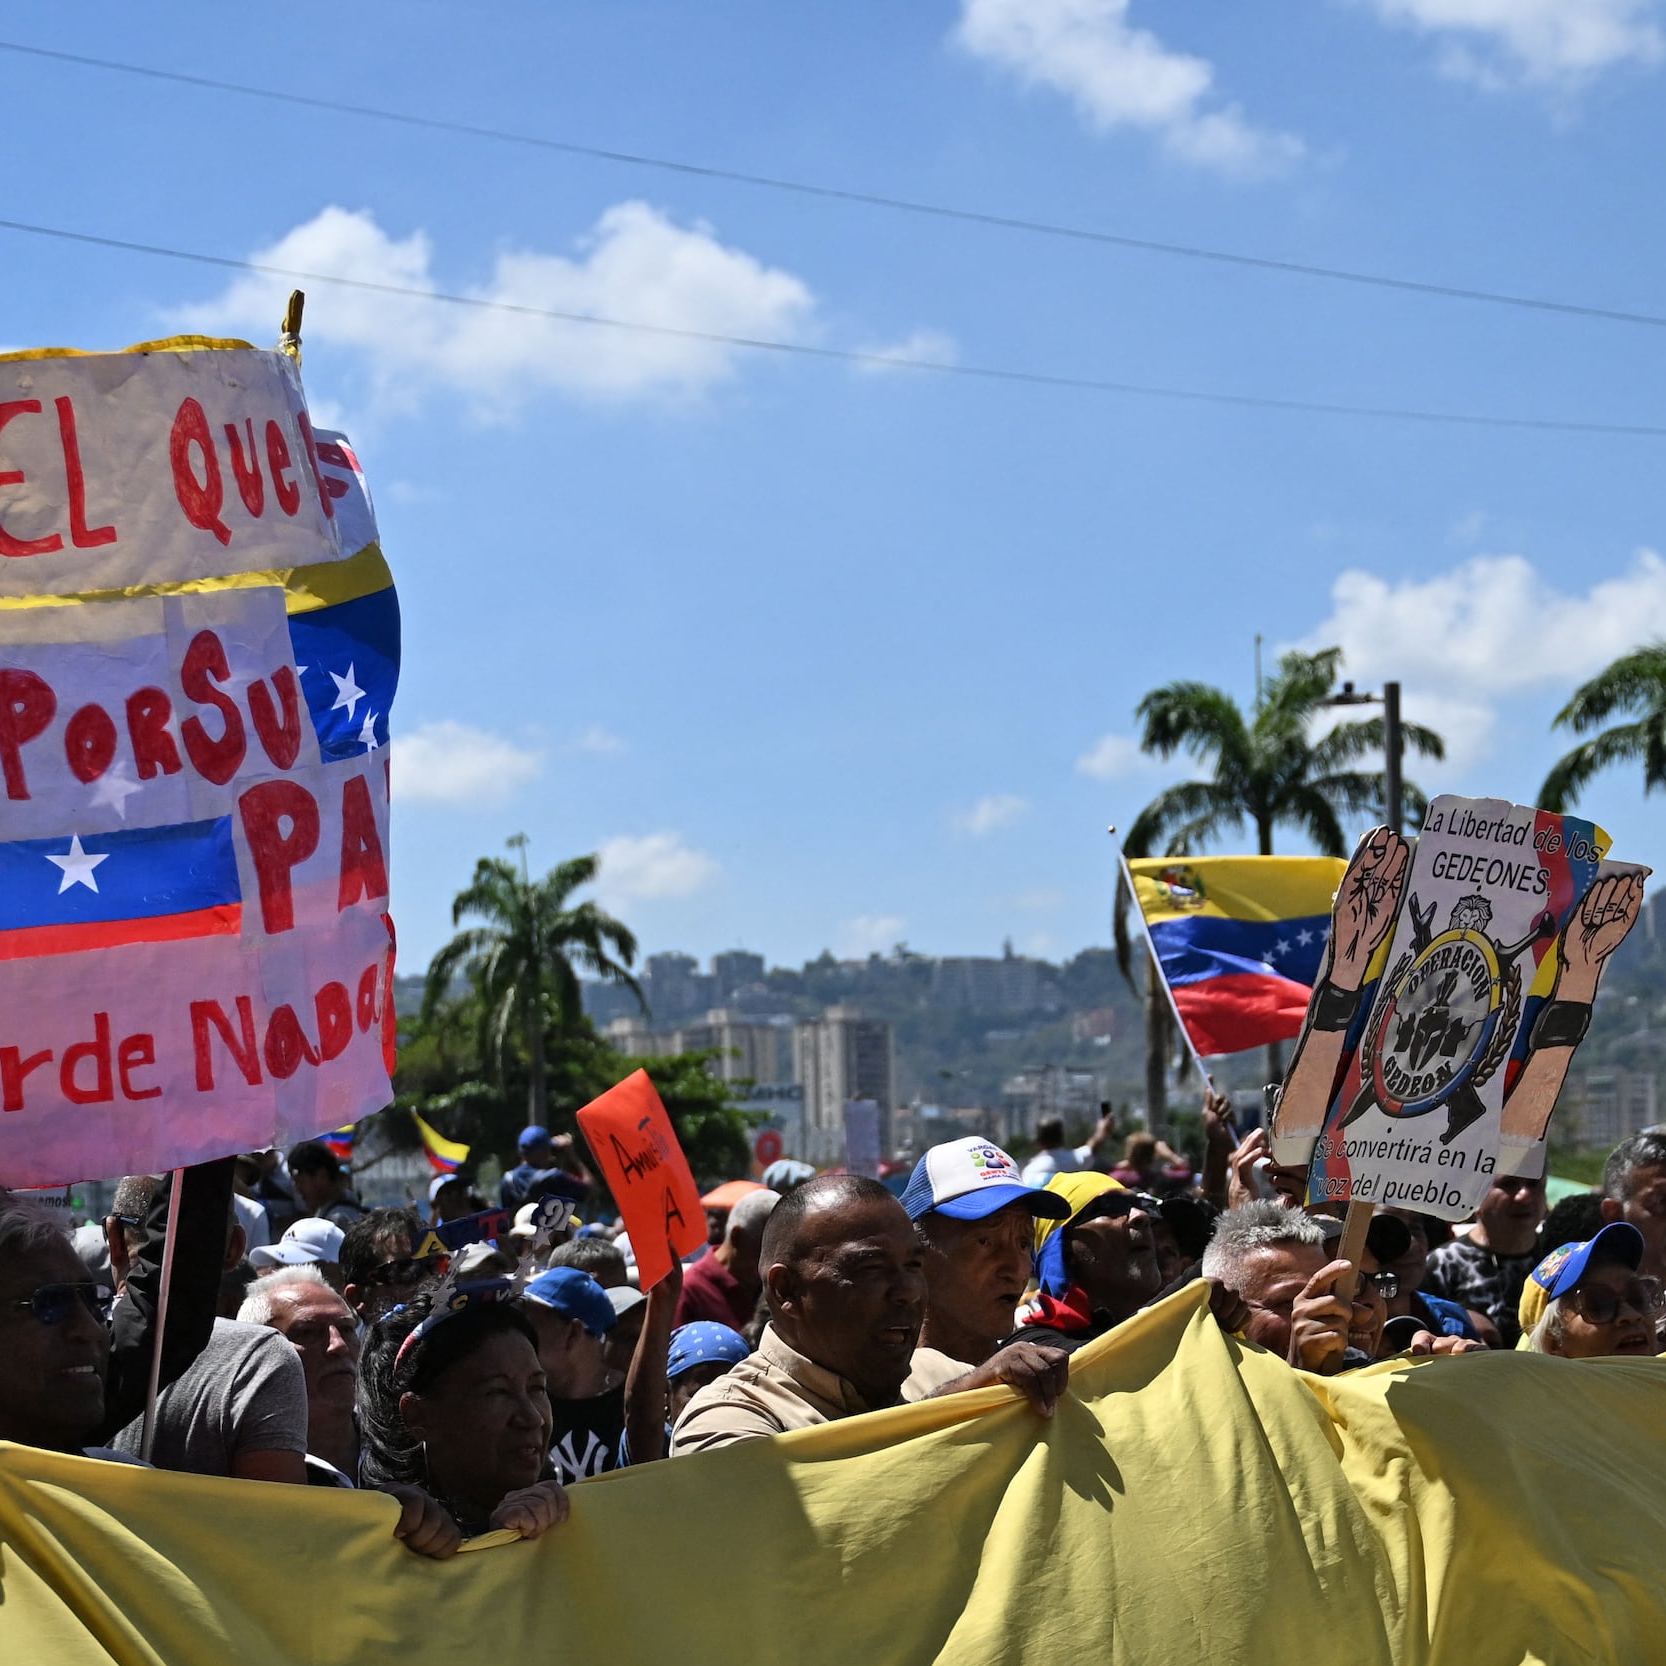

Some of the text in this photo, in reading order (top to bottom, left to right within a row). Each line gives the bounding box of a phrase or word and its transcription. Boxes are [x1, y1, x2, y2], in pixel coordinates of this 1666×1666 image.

[238, 757, 390, 935] PA
[1424, 805, 1604, 863] La Libertad de los
[1316, 1136, 1496, 1174] Se convertirá en la
[1316, 1177, 1349, 1197] voz
[1351, 1173, 1381, 1197] del
